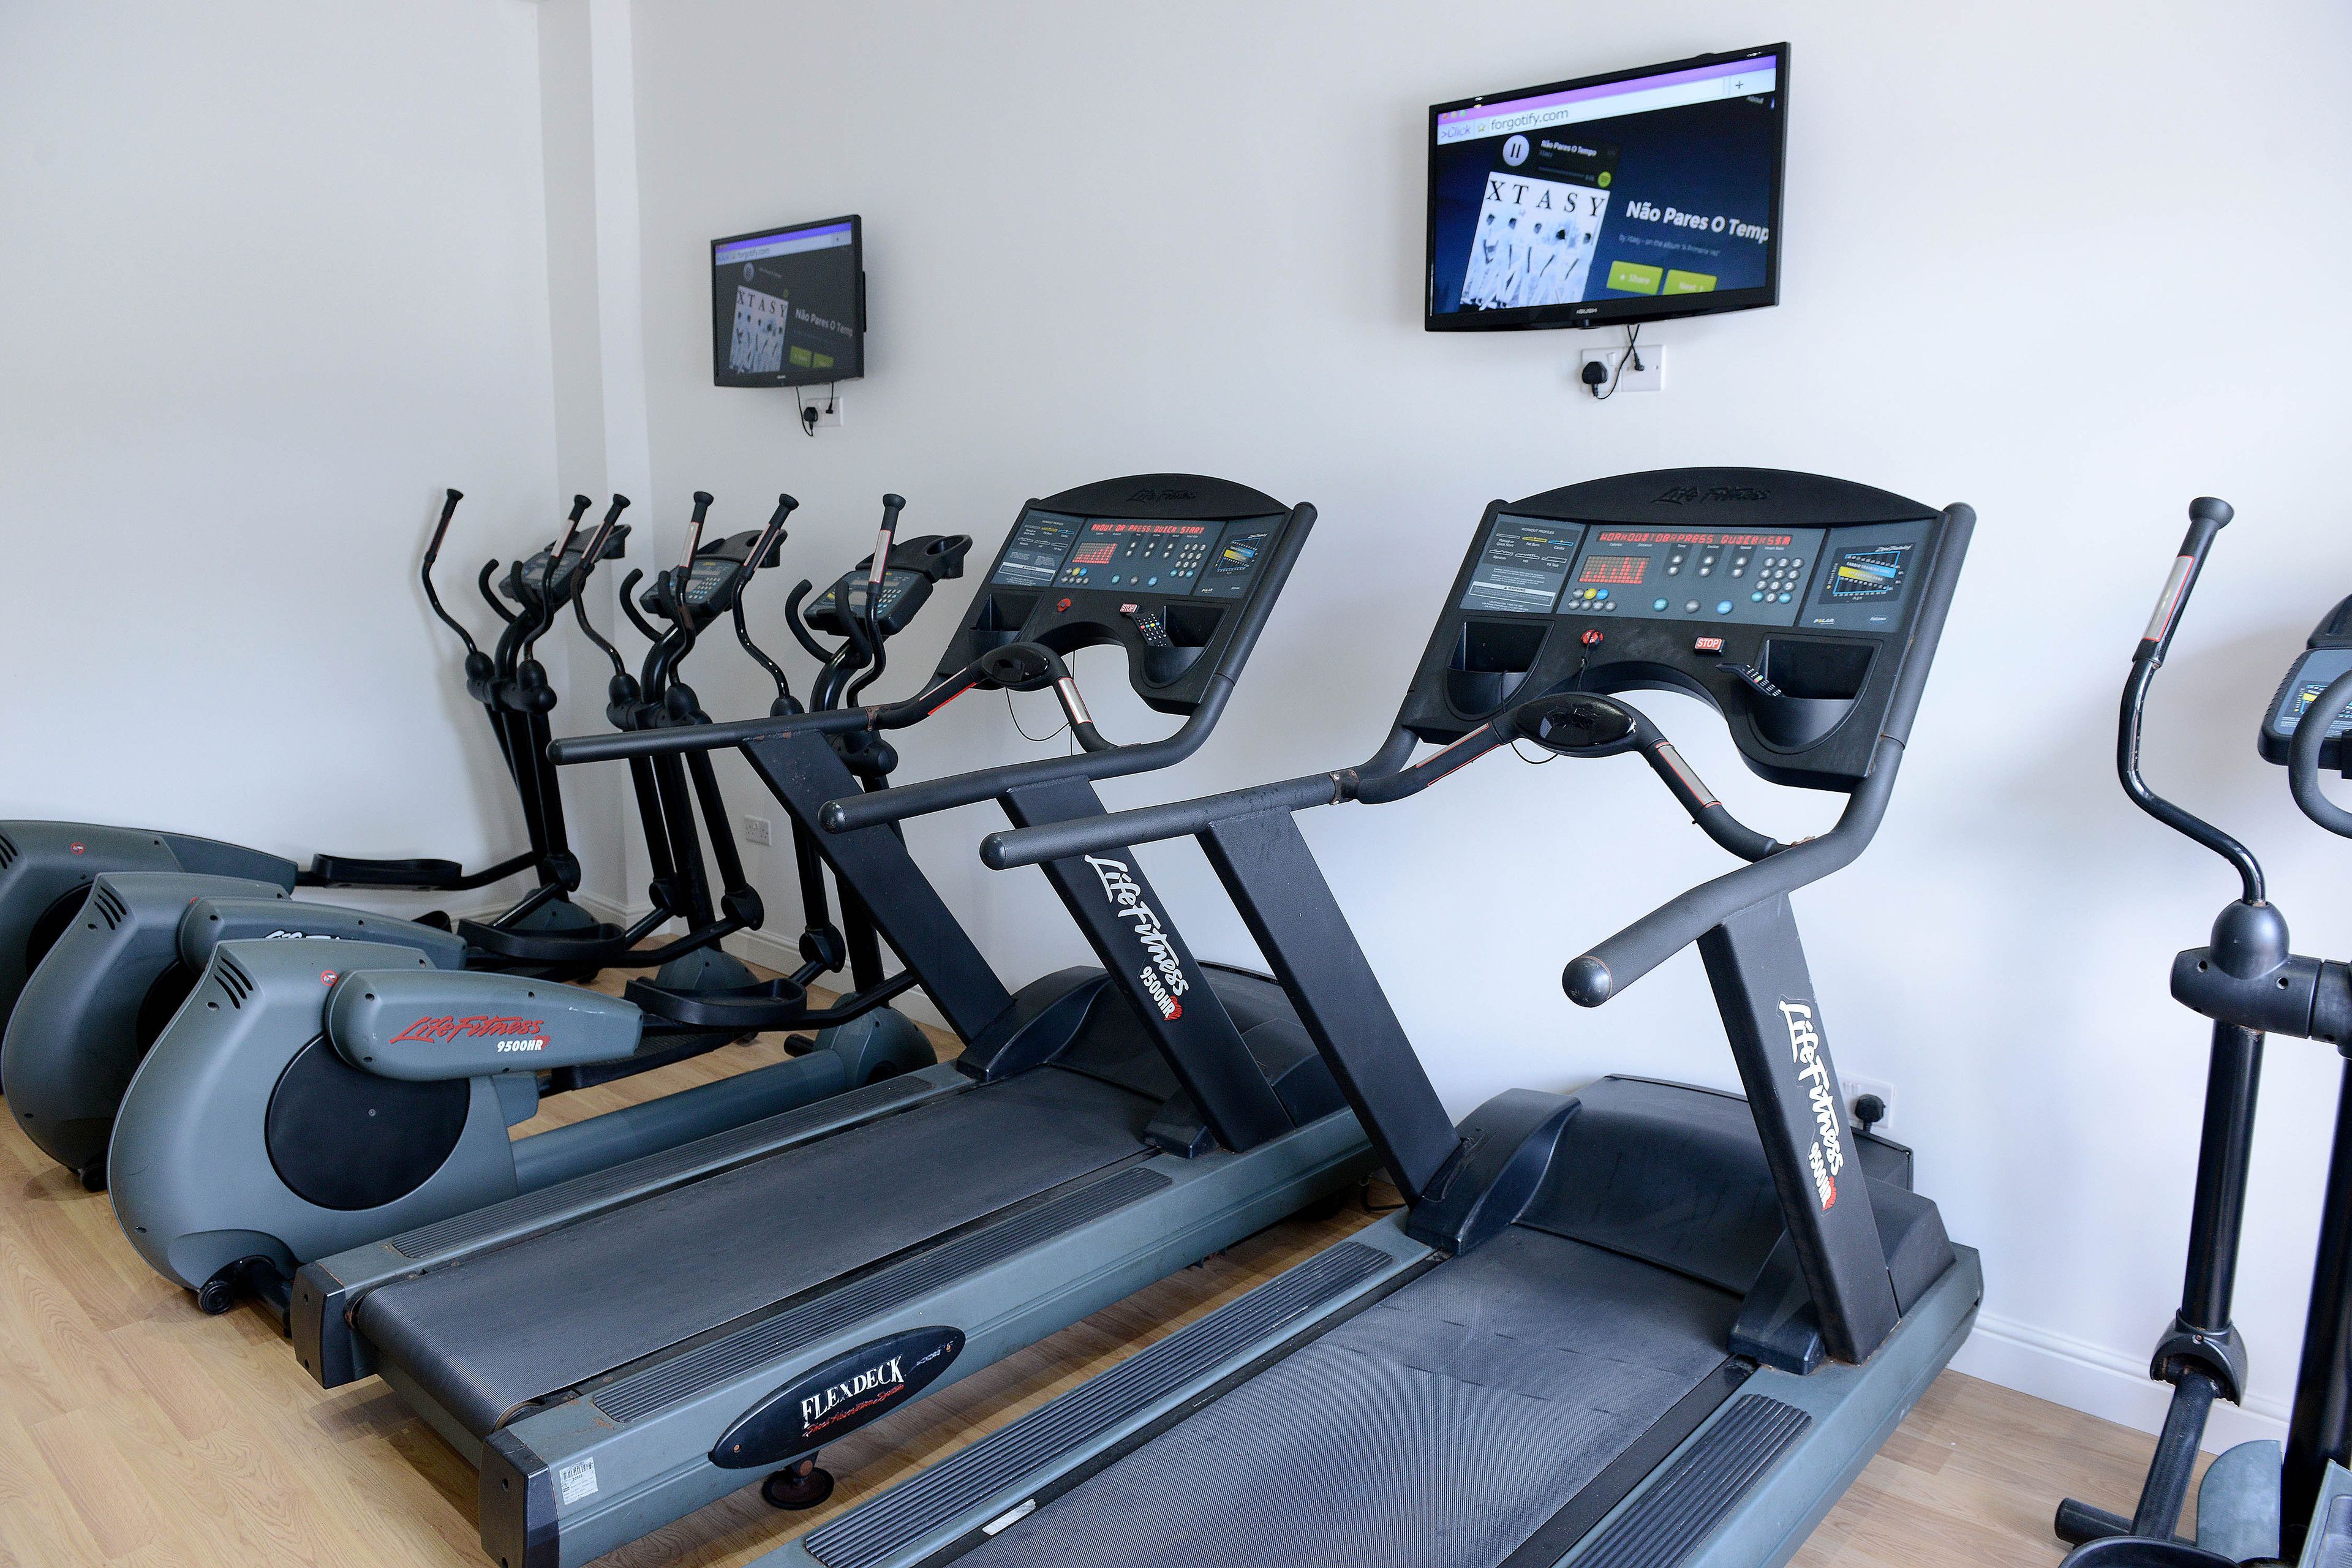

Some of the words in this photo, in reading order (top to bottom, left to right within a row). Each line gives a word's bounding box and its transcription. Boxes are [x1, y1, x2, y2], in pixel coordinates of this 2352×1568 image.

[1491, 108, 1569, 131] forgotify.com
[1626, 201, 1660, 222] Não
[1663, 207, 1709, 230] Pares
[1711, 216, 1725, 233] O
[1728, 218, 1770, 244] Temp
[1697, 639, 1719, 647] STOP
[1140, 966, 1175, 1019] 9500HR
[497, 1039, 544, 1052] 9500HR
[801, 1355, 905, 1430] FLEXDECK
